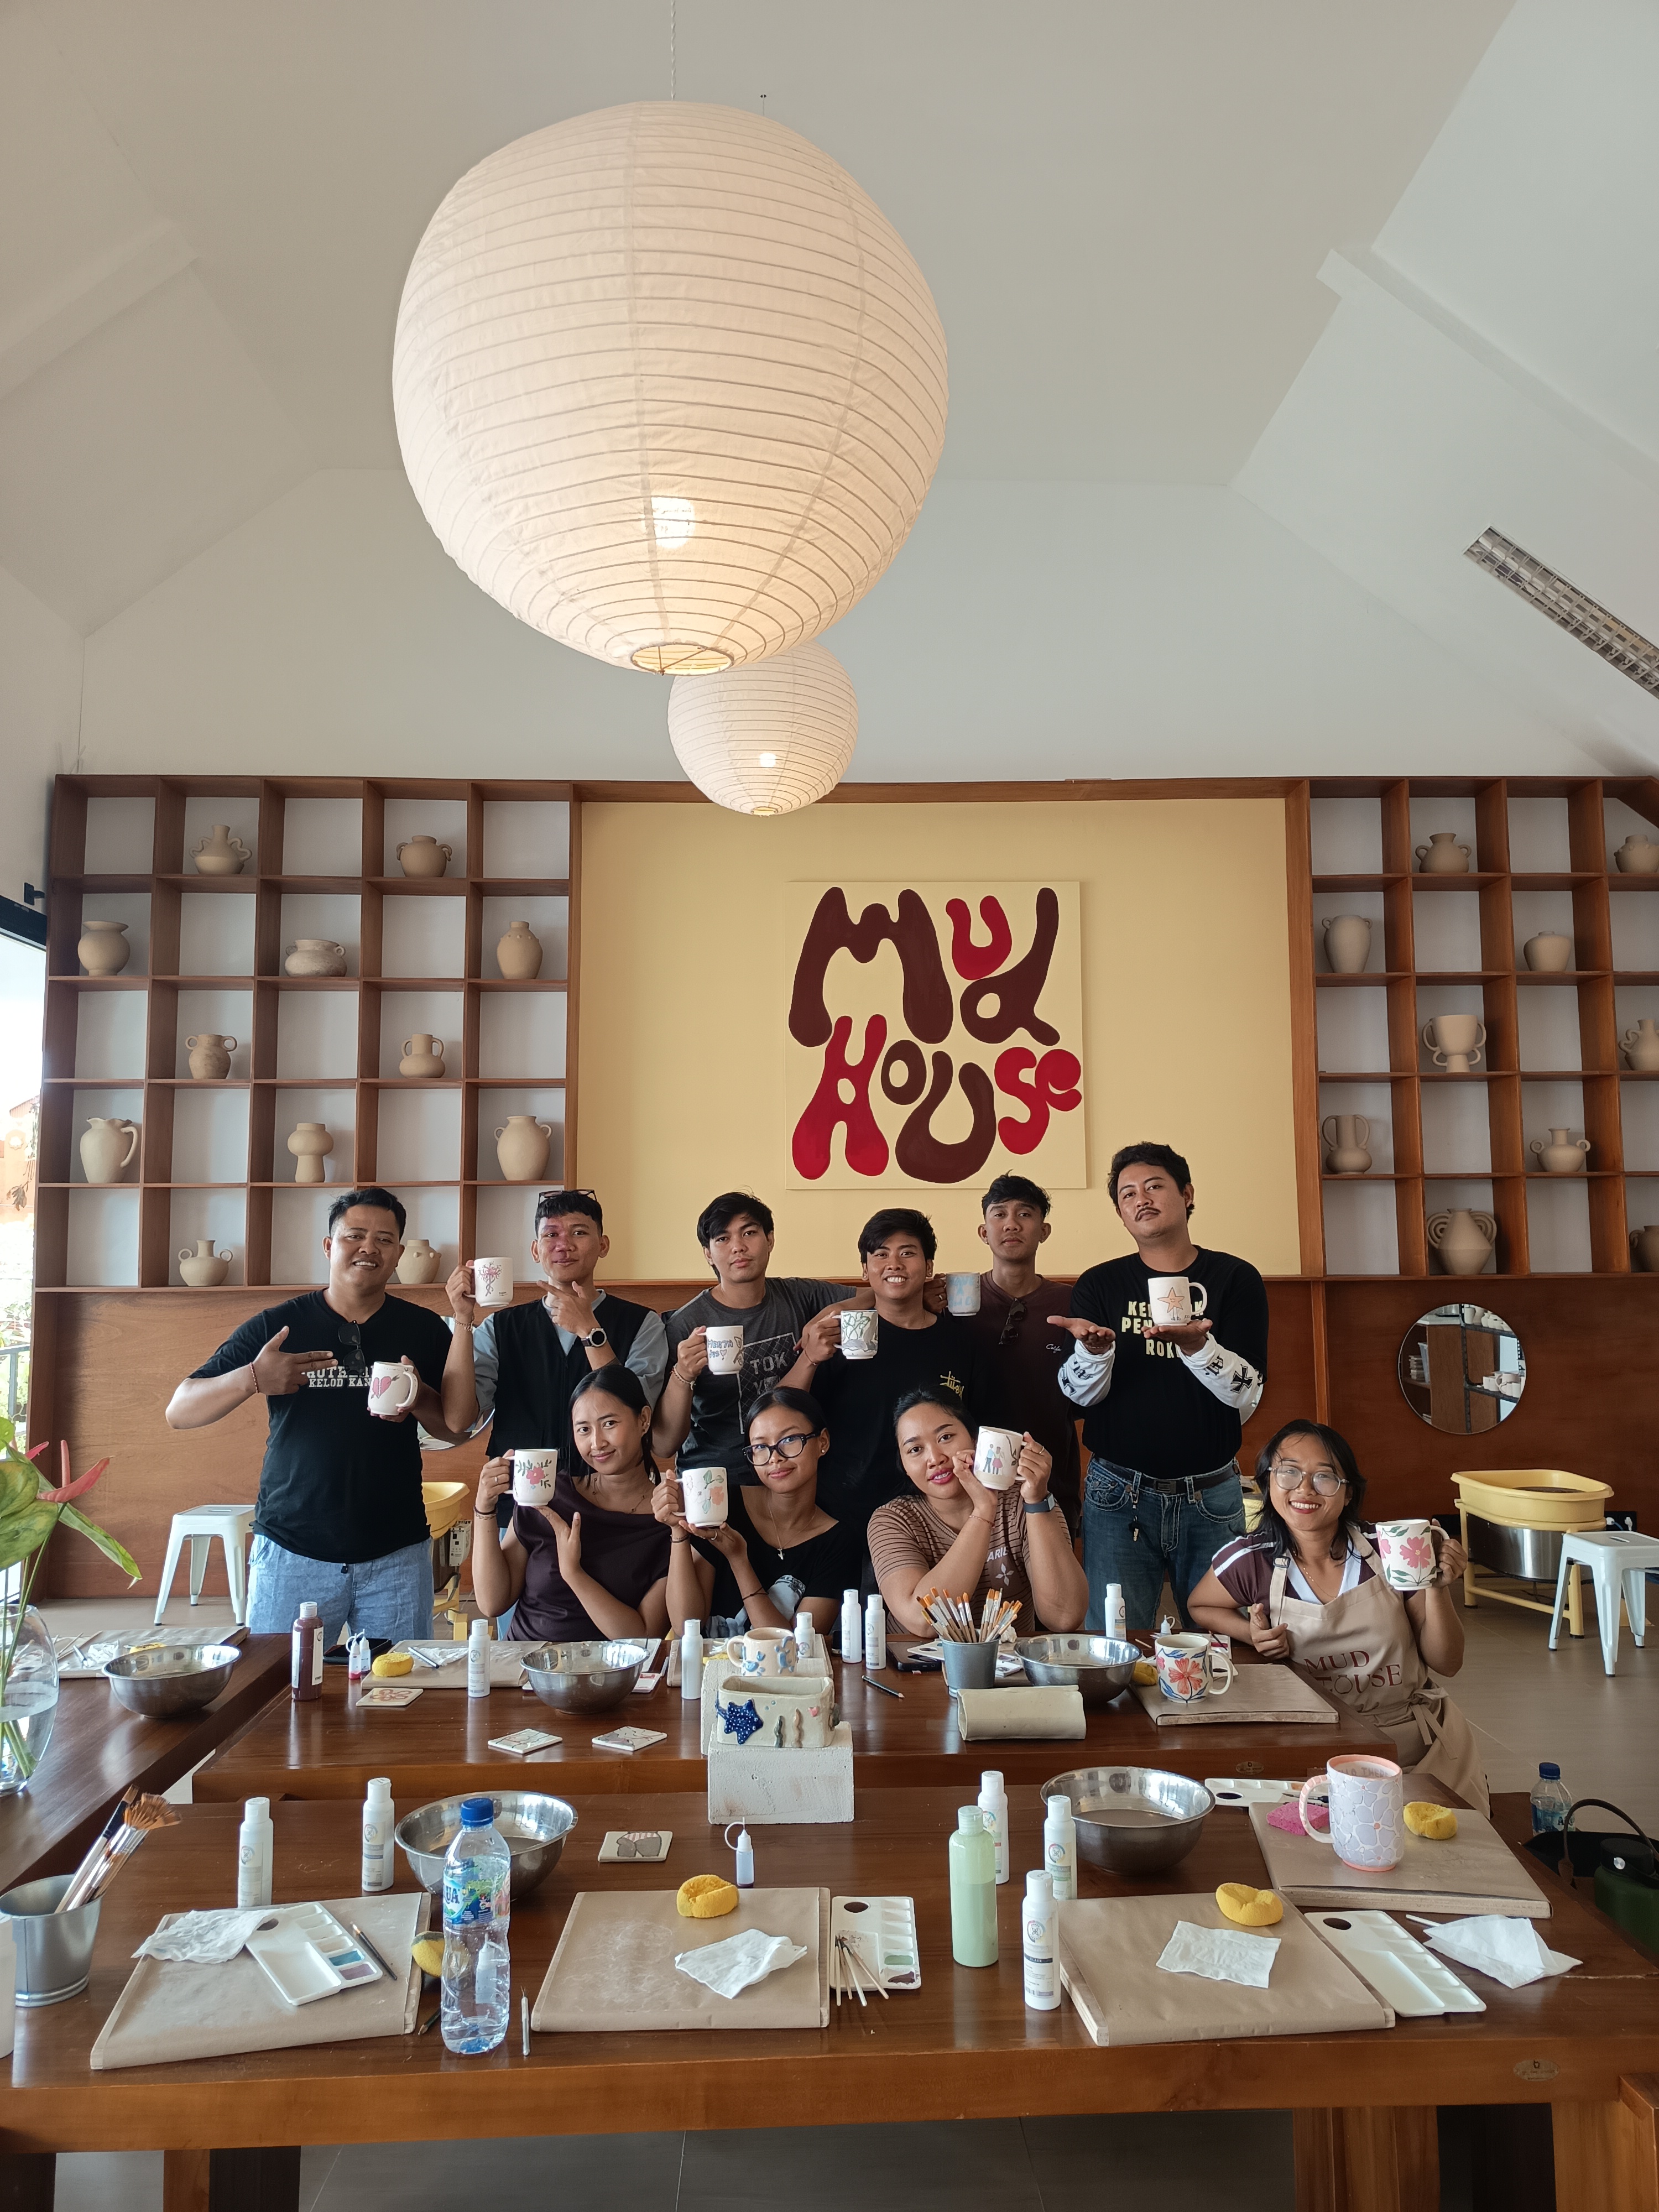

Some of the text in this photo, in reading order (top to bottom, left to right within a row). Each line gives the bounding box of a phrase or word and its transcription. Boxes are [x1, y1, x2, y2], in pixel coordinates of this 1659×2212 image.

[749, 1352, 787, 1375] TOK
[309, 1378, 343, 1387] KELOD
[1303, 1650, 1370, 1674] MUD
